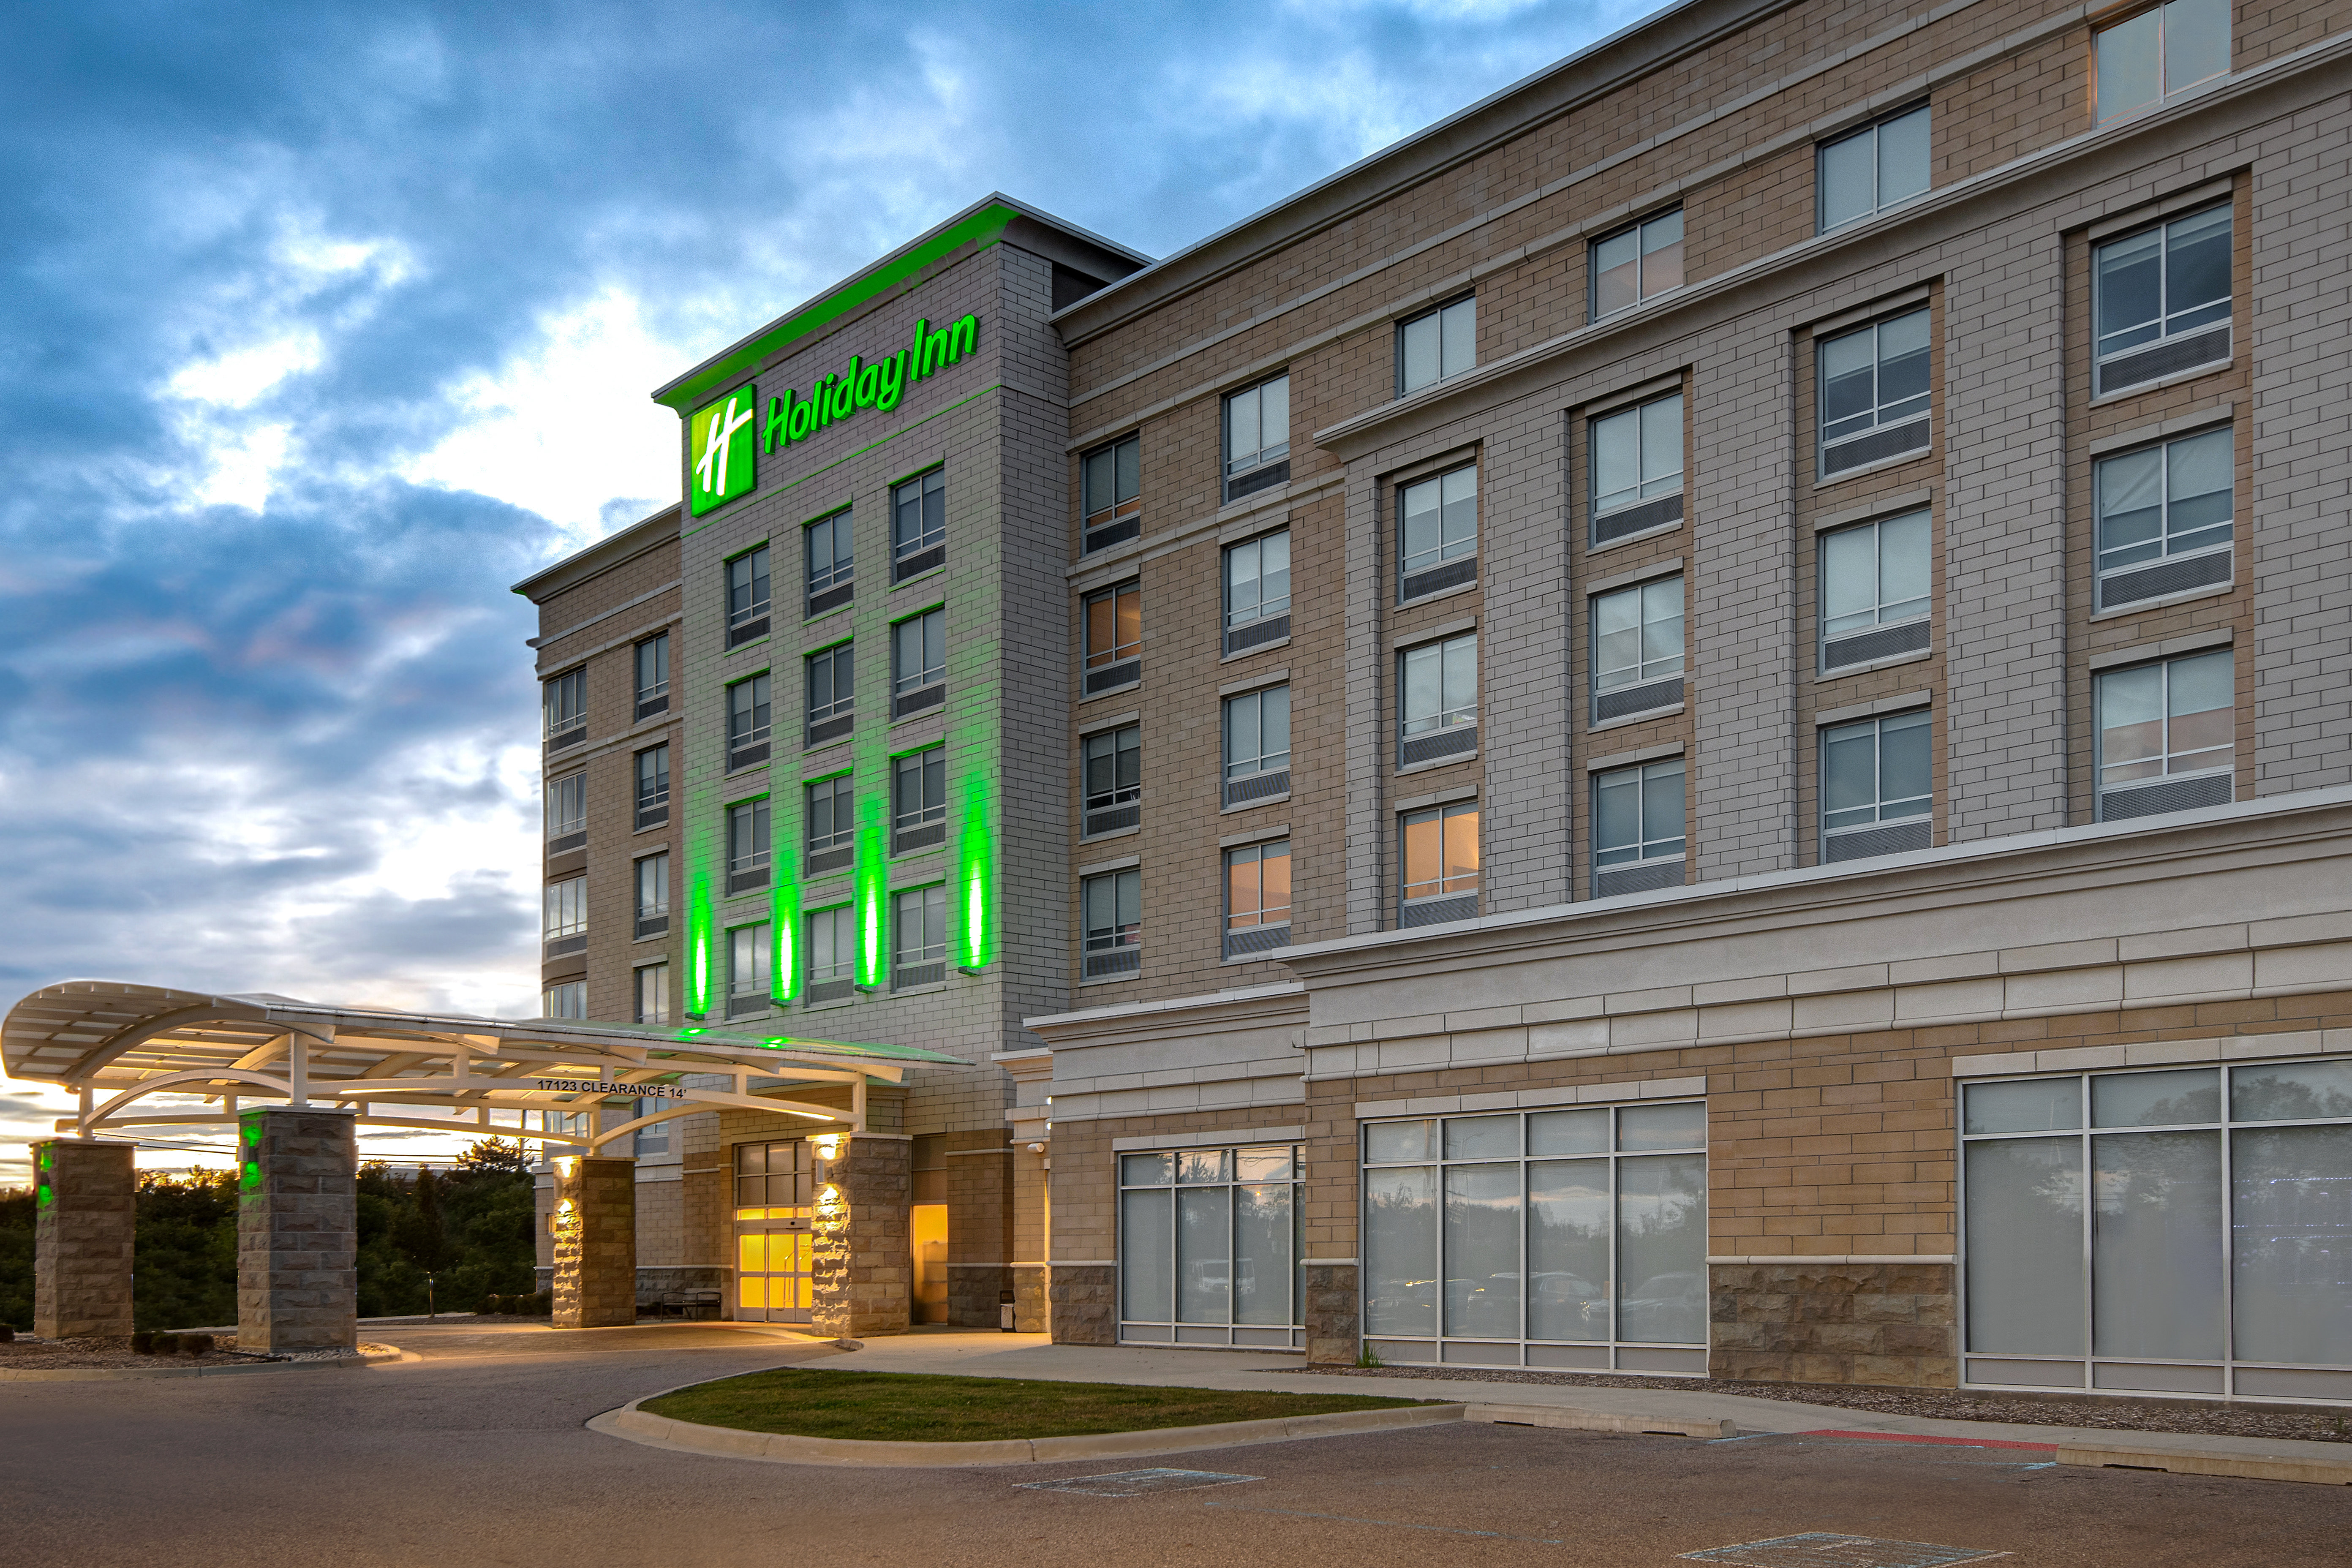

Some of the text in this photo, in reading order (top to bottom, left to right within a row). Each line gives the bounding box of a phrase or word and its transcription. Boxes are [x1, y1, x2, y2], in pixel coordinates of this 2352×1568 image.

[762, 314, 980, 455] Holiday Inn
[695, 397, 753, 496] H
[538, 1080, 686, 1098] 17123 CLEARANCE 14'
